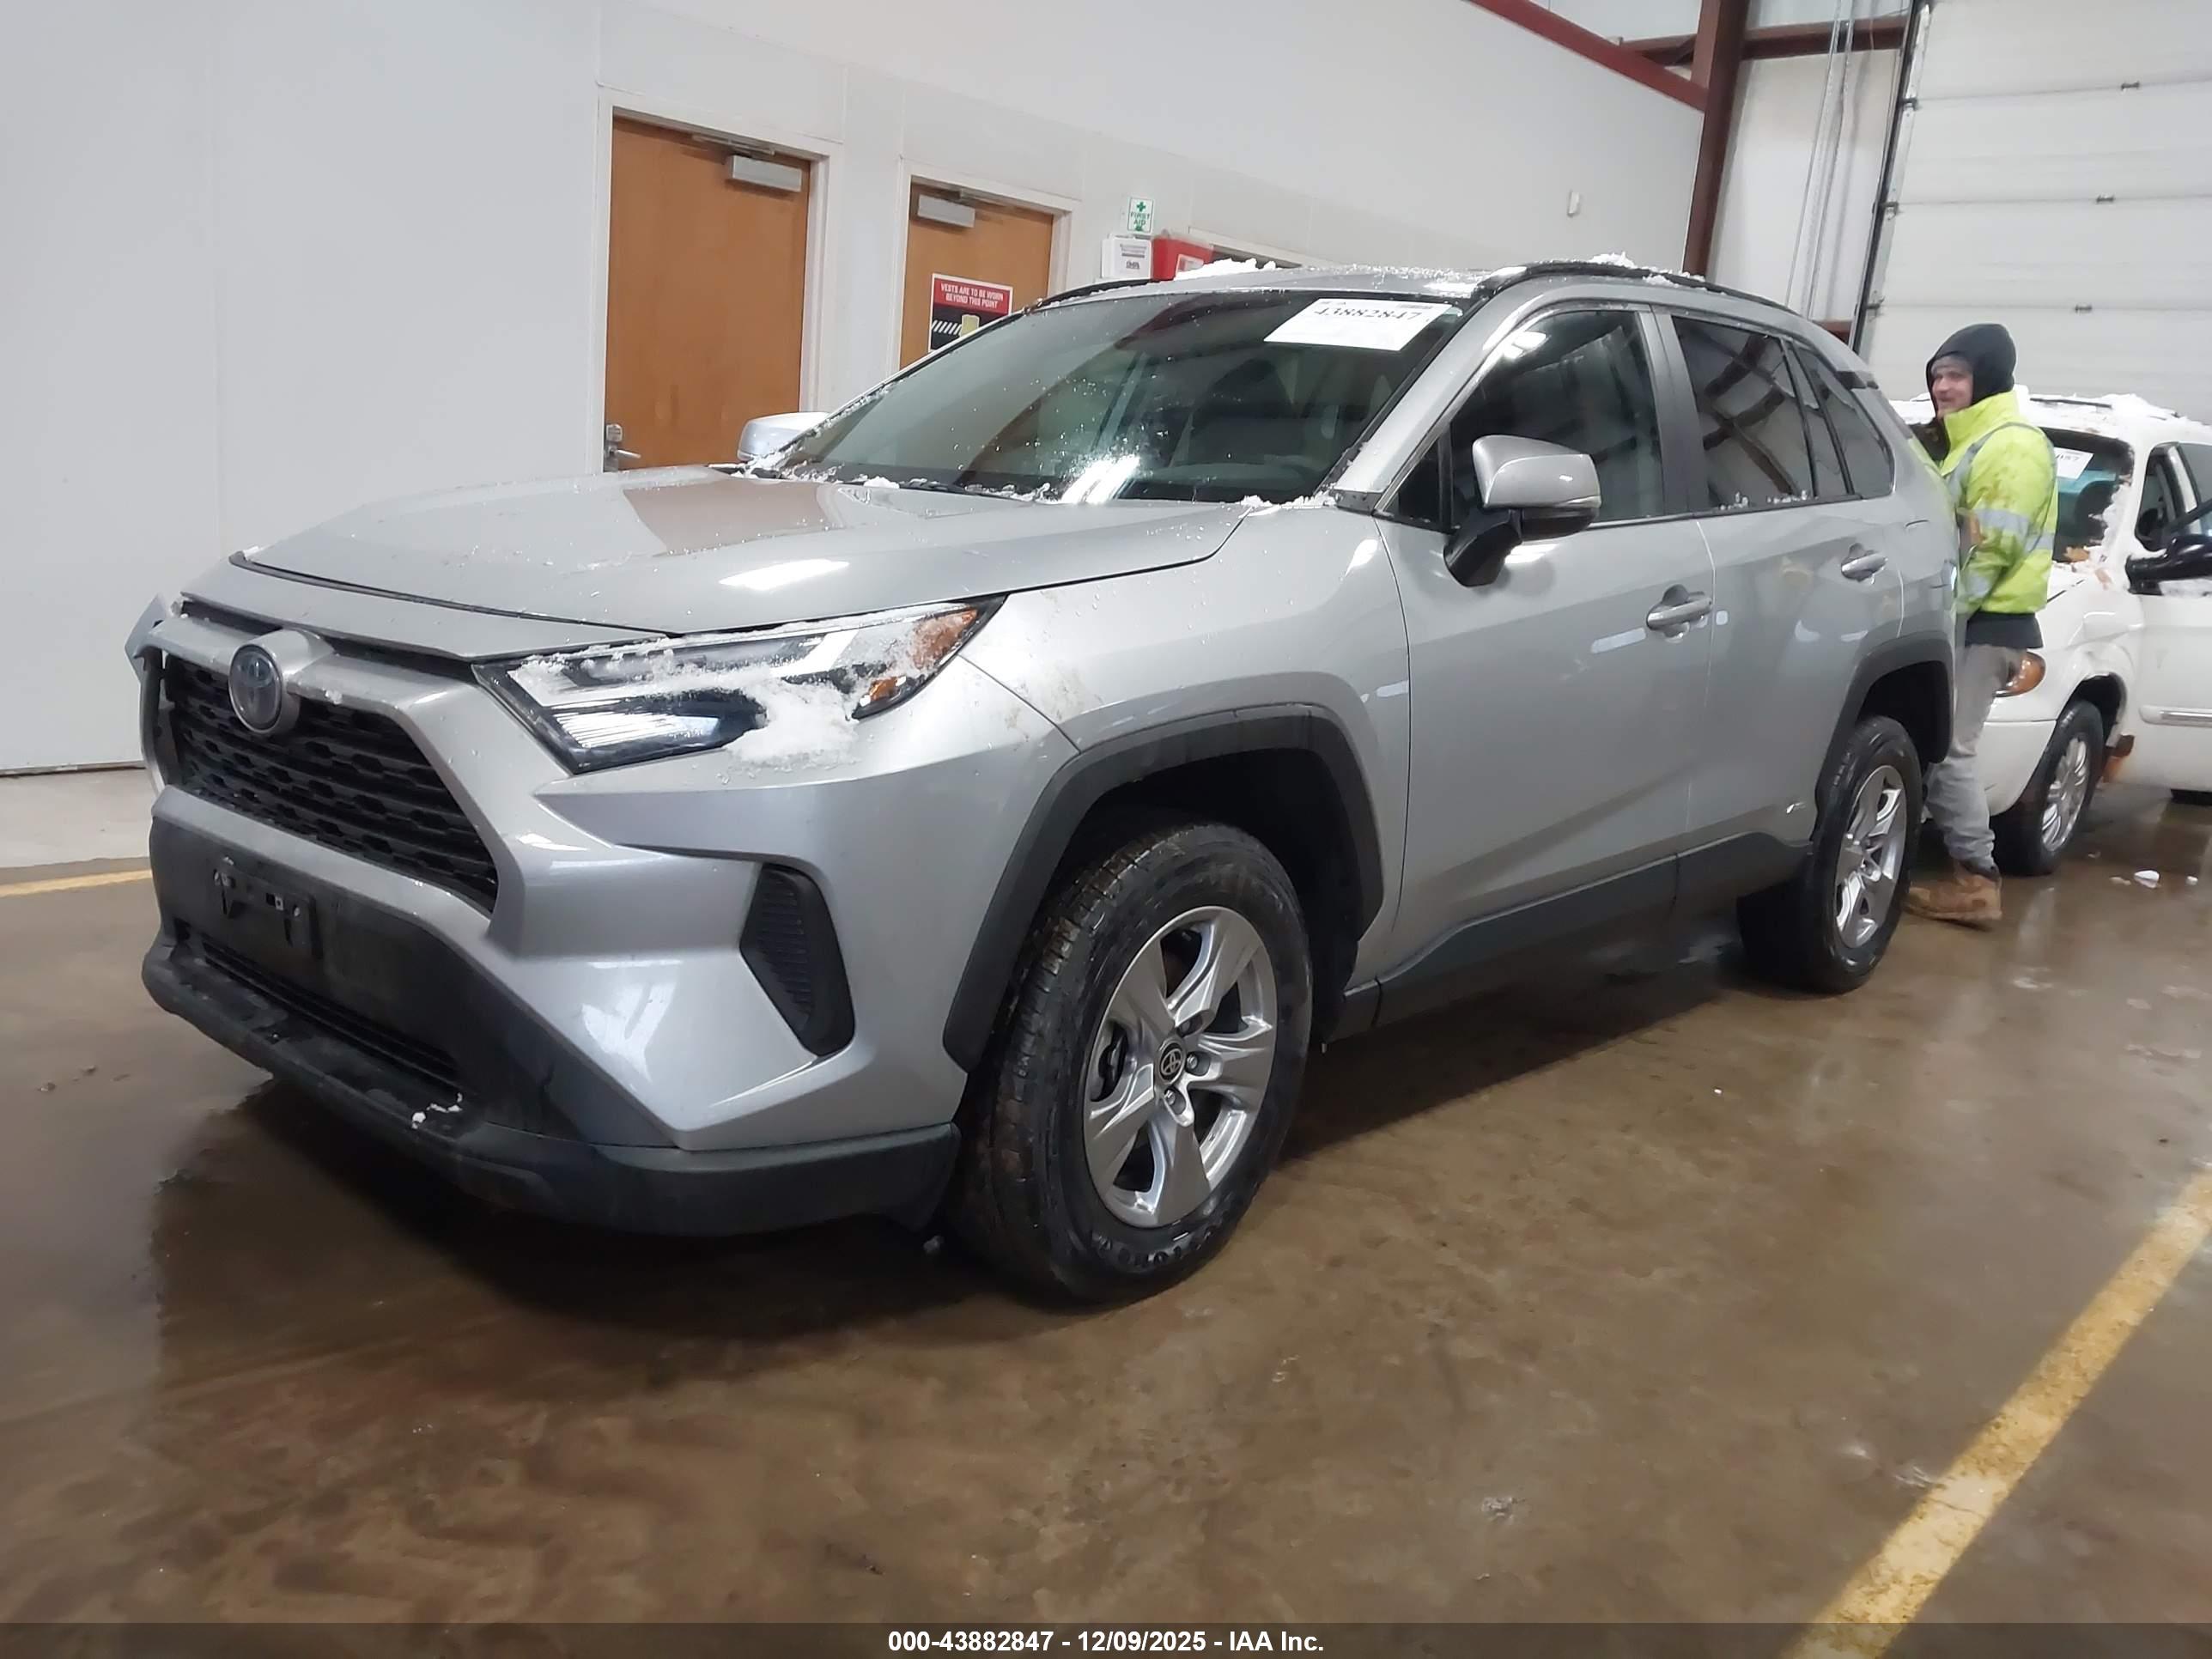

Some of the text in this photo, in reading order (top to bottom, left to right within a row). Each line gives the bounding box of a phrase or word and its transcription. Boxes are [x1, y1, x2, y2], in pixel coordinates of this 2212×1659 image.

[1130, 211, 1150, 220] FIRST
[940, 283, 958, 292] VESTS
[959, 286, 970, 295] ARE
[971, 288, 977, 296] TO
[987, 290, 1003, 301] WORN
[945, 293, 999, 308] BEYOND THIS POINT
[1313, 307, 1422, 319] 43882847
